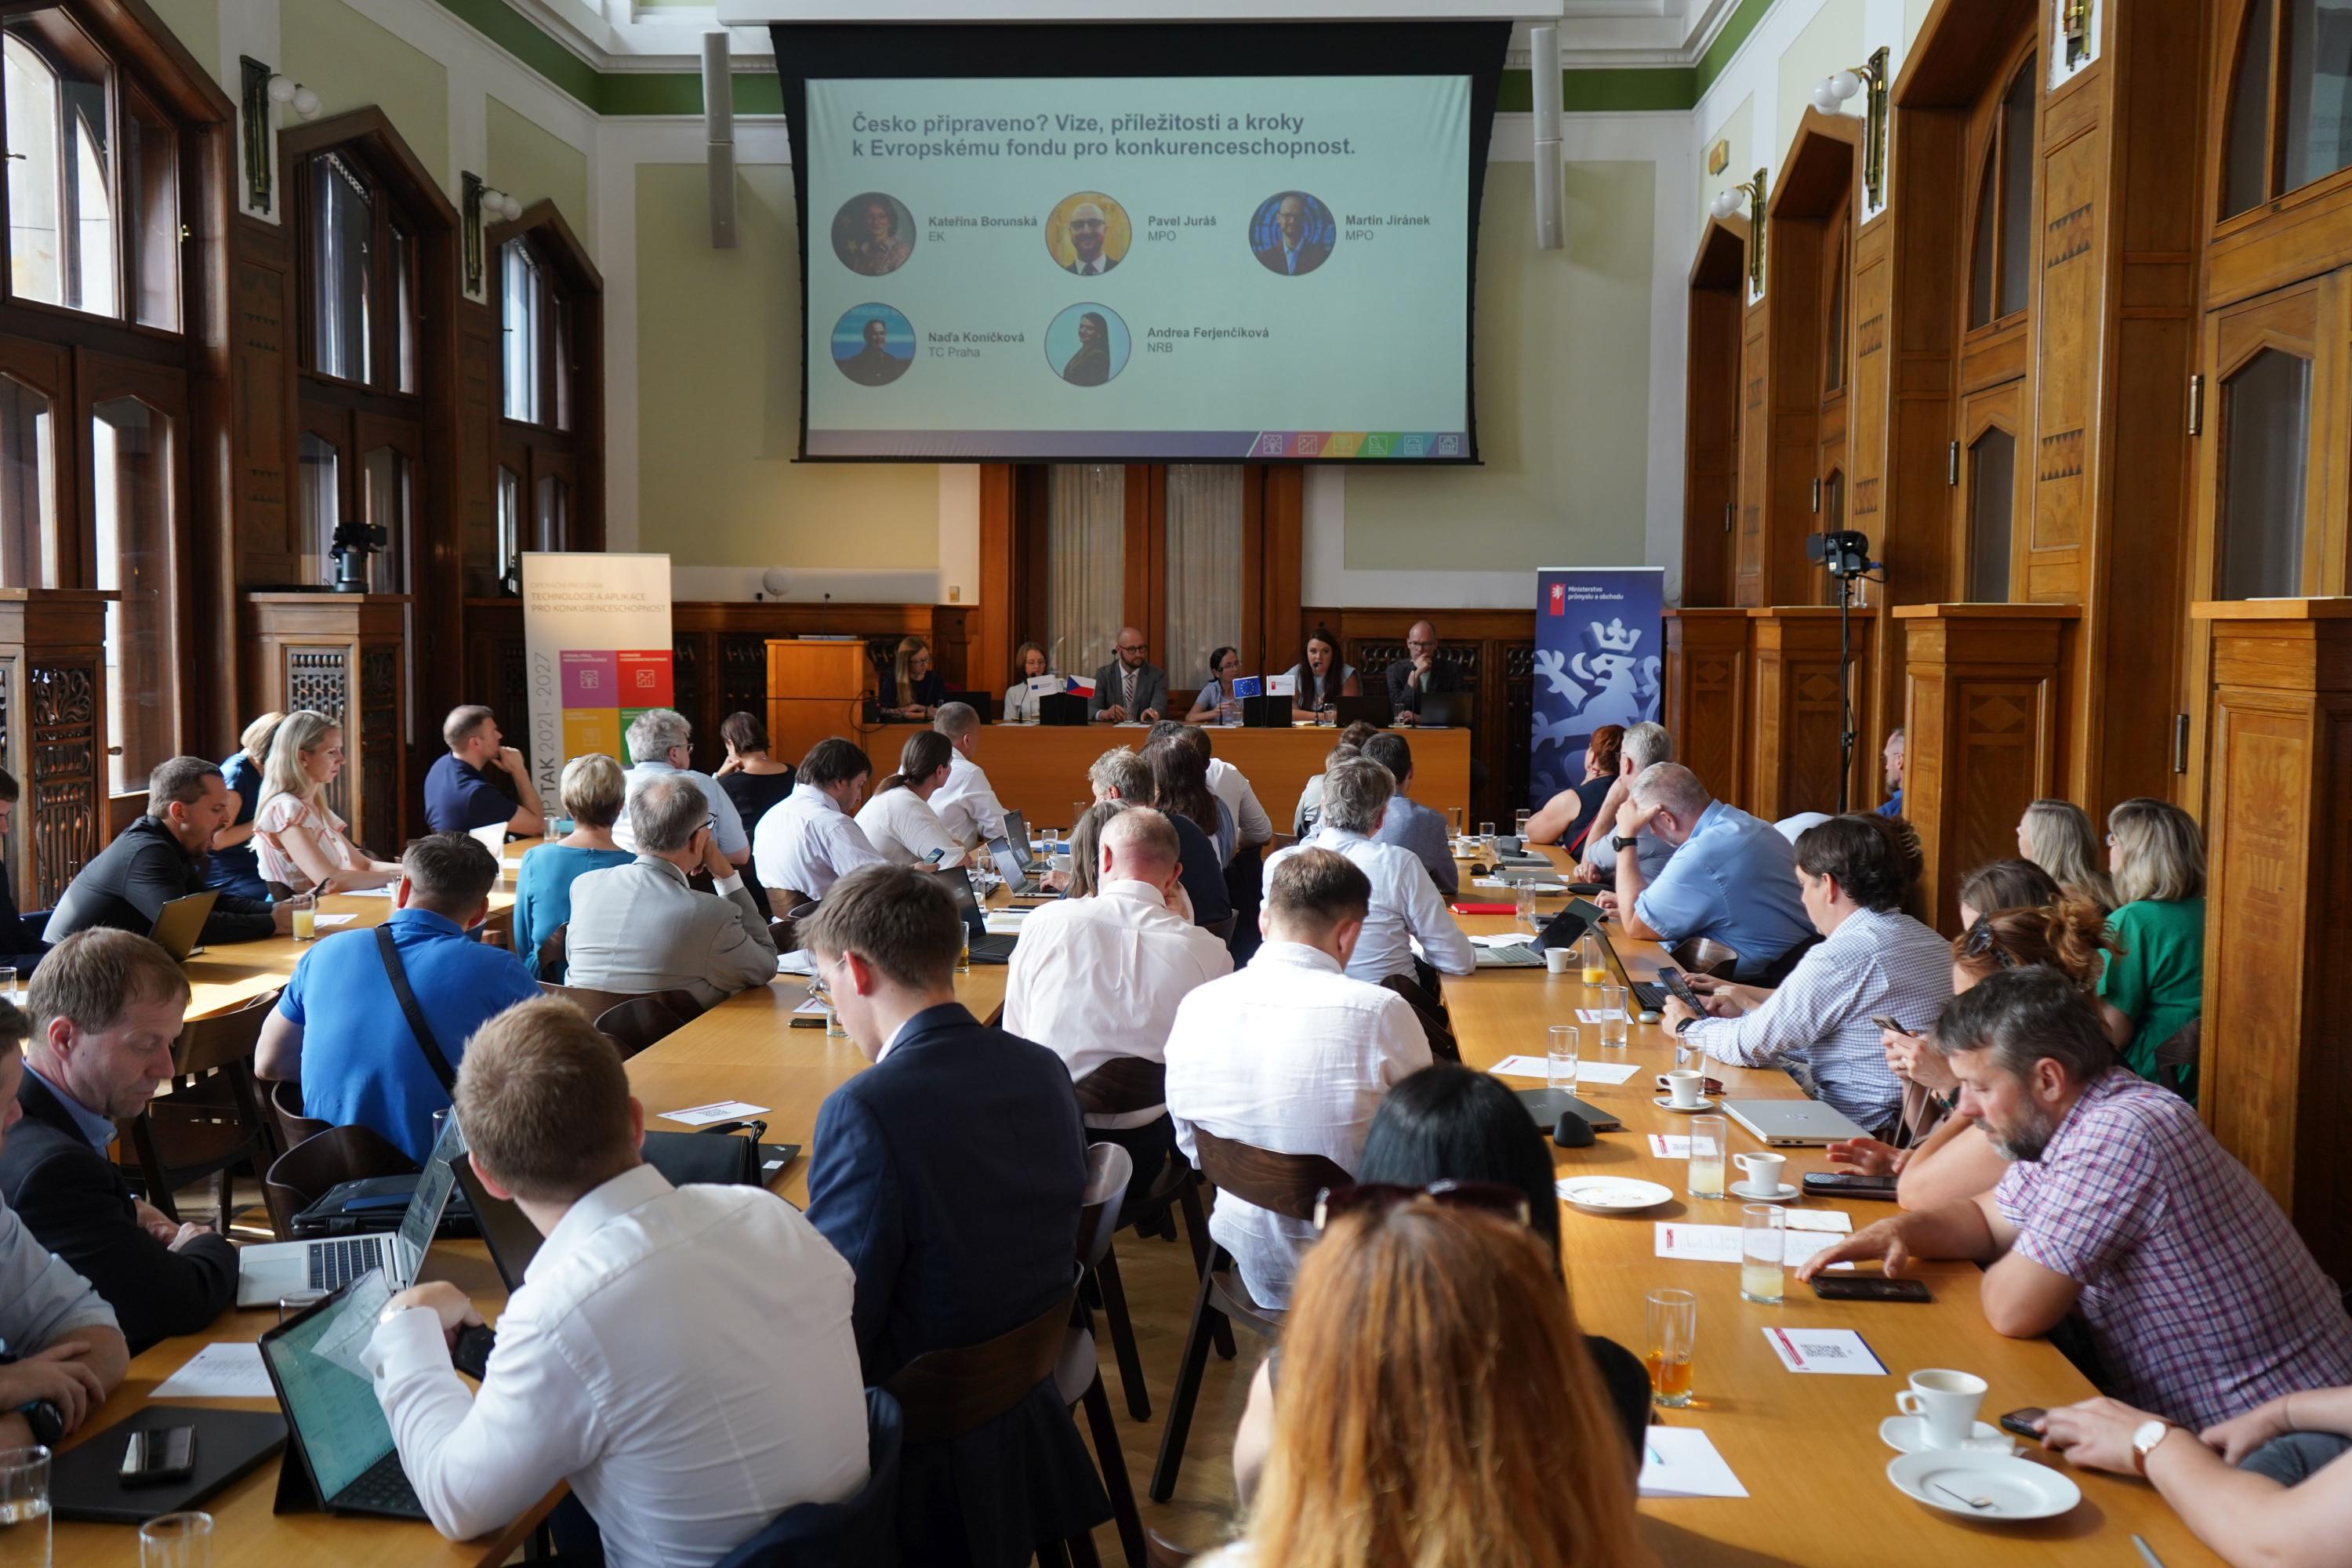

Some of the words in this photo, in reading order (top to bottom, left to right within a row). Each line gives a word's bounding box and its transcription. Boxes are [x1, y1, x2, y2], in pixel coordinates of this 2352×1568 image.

[852, 111, 916, 132] Česko
[924, 114, 1049, 136] připraveno?
[1054, 114, 1104, 134] Vize,
[1112, 113, 1221, 136] příležitosti
[1227, 117, 1239, 131] a
[1246, 113, 1305, 134] kroky
[852, 140, 864, 156] k
[870, 138, 1000, 160] Evropskému
[1007, 138, 1066, 156] fondu
[1074, 141, 1108, 160] pro
[1116, 137, 1356, 158] konkurenceschopnost.
[928, 216, 978, 227] Kateřina
[981, 215, 1038, 227] Borunská
[1148, 216, 1180, 227] Pavel
[1184, 215, 1217, 227] Juráš
[1345, 214, 1383, 226] Martin
[1386, 214, 1431, 226] Jiránek
[928, 231, 946, 241] EK
[1148, 230, 1176, 241] MPO
[1345, 230, 1374, 241] MPO
[928, 332, 960, 342] Naďa
[1147, 327, 1189, 338] Andrea
[1193, 327, 1269, 340] Ferjenčíková
[928, 347, 945, 358] TC
[948, 347, 980, 358] Praha
[1147, 342, 1173, 353] NRB
[531, 592, 595, 601] TECHNOLOGIE
[604, 592, 646, 601] APLIKACE
[531, 604, 551, 613] PRO
[553, 604, 667, 613] KONKURENCESCHOPNOST
[539, 758, 555, 794] TAK
